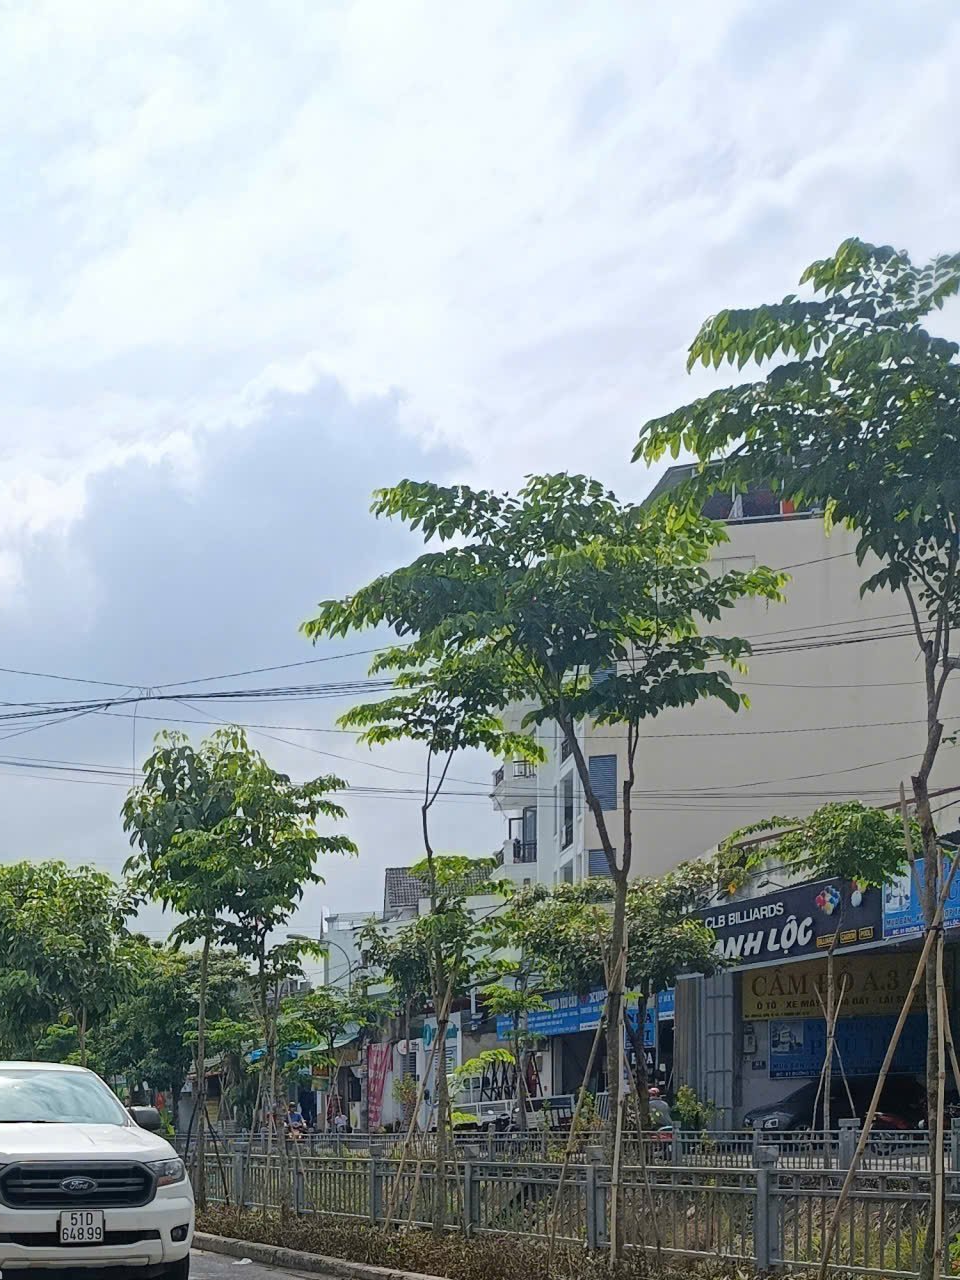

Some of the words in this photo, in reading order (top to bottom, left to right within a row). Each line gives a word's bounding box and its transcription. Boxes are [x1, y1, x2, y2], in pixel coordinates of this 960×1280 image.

[705, 915, 725, 929] CLB
[728, 902, 784, 925] BILLIARDS
[767, 915, 813, 955] LỘC
[70, 1181, 89, 1190] Ford
[71, 1213, 93, 1226] 51D
[62, 1227, 102, 1241] 648.99
